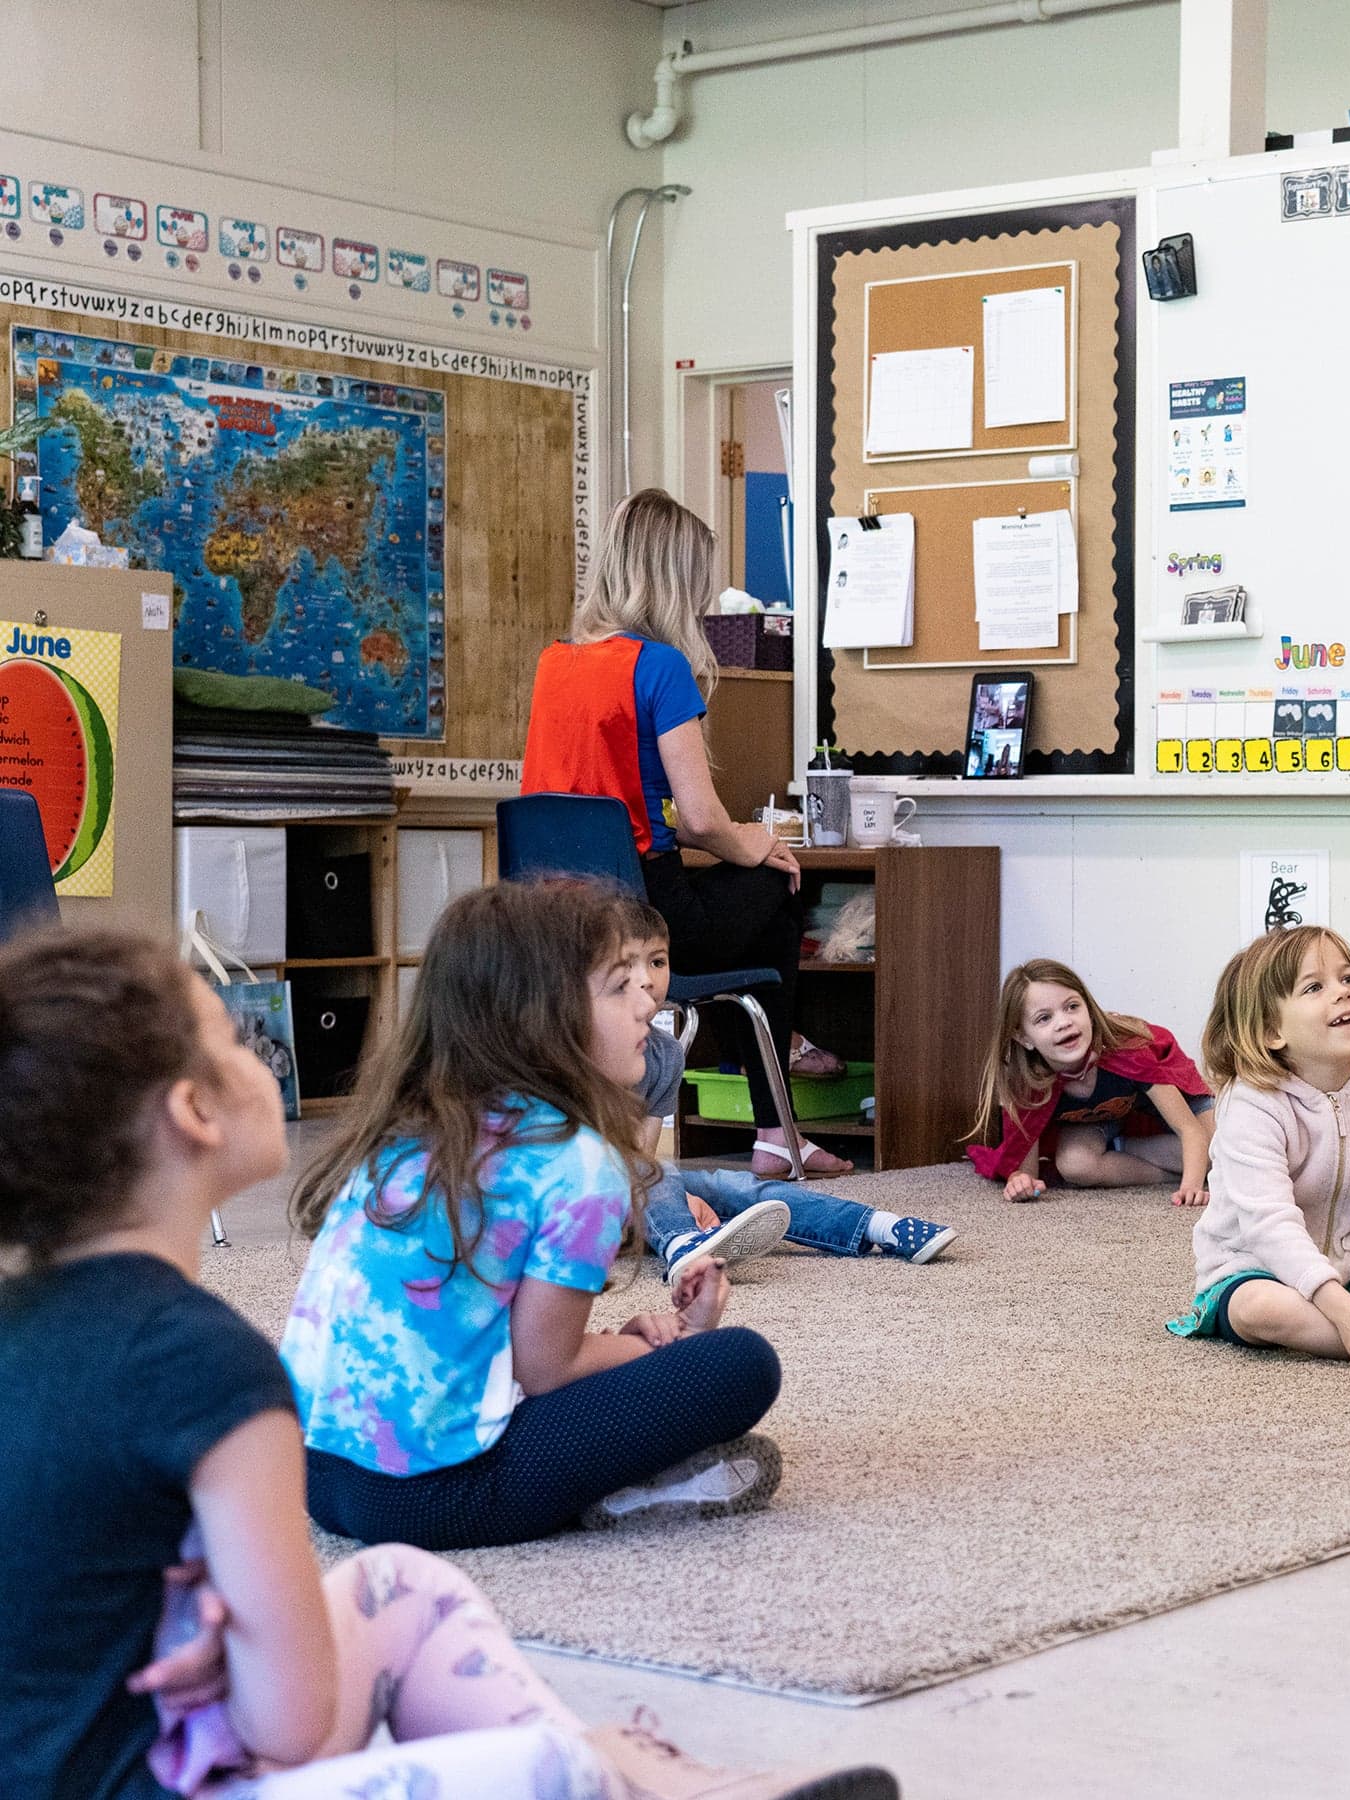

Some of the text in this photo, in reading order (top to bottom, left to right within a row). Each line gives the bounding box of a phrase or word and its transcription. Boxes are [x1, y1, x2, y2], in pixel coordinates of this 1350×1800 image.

[1167, 552, 1223, 577] Spring
[6, 627, 72, 659] June
[1274, 635, 1346, 670] June
[1191, 690, 1213, 699] Tuesday
[1282, 687, 1299, 696] Friday
[1307, 687, 1333, 696] Saturday
[0, 752, 44, 767] rmelon
[1174, 753, 1180, 768] 1
[1202, 752, 1209, 768] 2
[1231, 752, 1240, 767] 3
[1260, 751, 1269, 767] 4
[1291, 752, 1300, 767] 5
[1321, 752, 1330, 767] 6
[0, 771, 33, 786] nade
[1271, 861, 1299, 874] Bear
